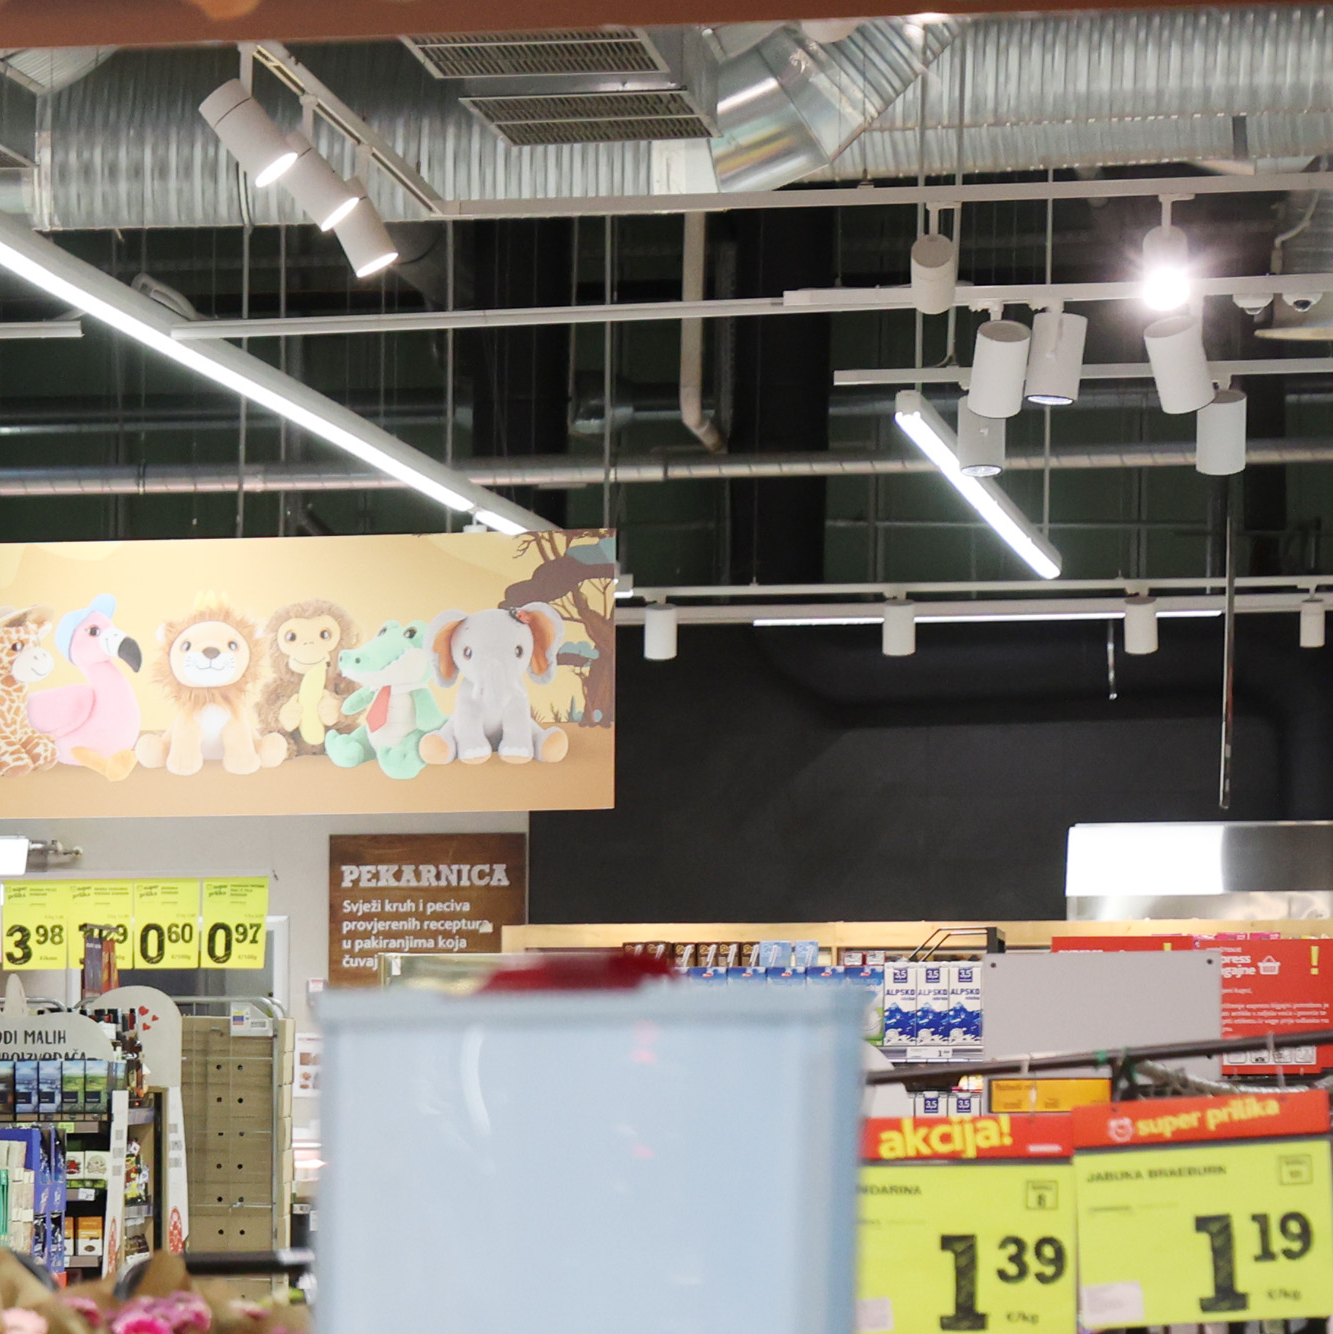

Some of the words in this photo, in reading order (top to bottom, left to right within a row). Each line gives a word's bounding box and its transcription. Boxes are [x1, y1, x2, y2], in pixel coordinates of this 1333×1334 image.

[340, 863, 510, 887] PEKARNICA
[342, 899, 382, 916] Svježi
[384, 899, 416, 913] kruh
[419, 899, 424, 913] i
[426, 899, 471, 915] peciva
[342, 917, 421, 935] provjerenih
[5, 924, 33, 965] 3
[35, 924, 65, 945] 98
[140, 923, 165, 964] 0
[167, 922, 194, 944] 60
[207, 922, 233, 964] 0
[235, 922, 263, 944] 97
[341, 938, 352, 949] u
[354, 936, 435, 952] pakiranjima
[437, 935, 467, 952] koja
[24, 1030, 66, 1045] MALIH
[879, 1114, 1014, 1160] akcija!
[1135, 1107, 1202, 1138] super
[1206, 1096, 1281, 1132] prilika
[940, 1234, 989, 1331] 1
[996, 1235, 1066, 1285] 39
[1194, 1214, 1249, 1313] 1
[1251, 1212, 1313, 1263] 19
